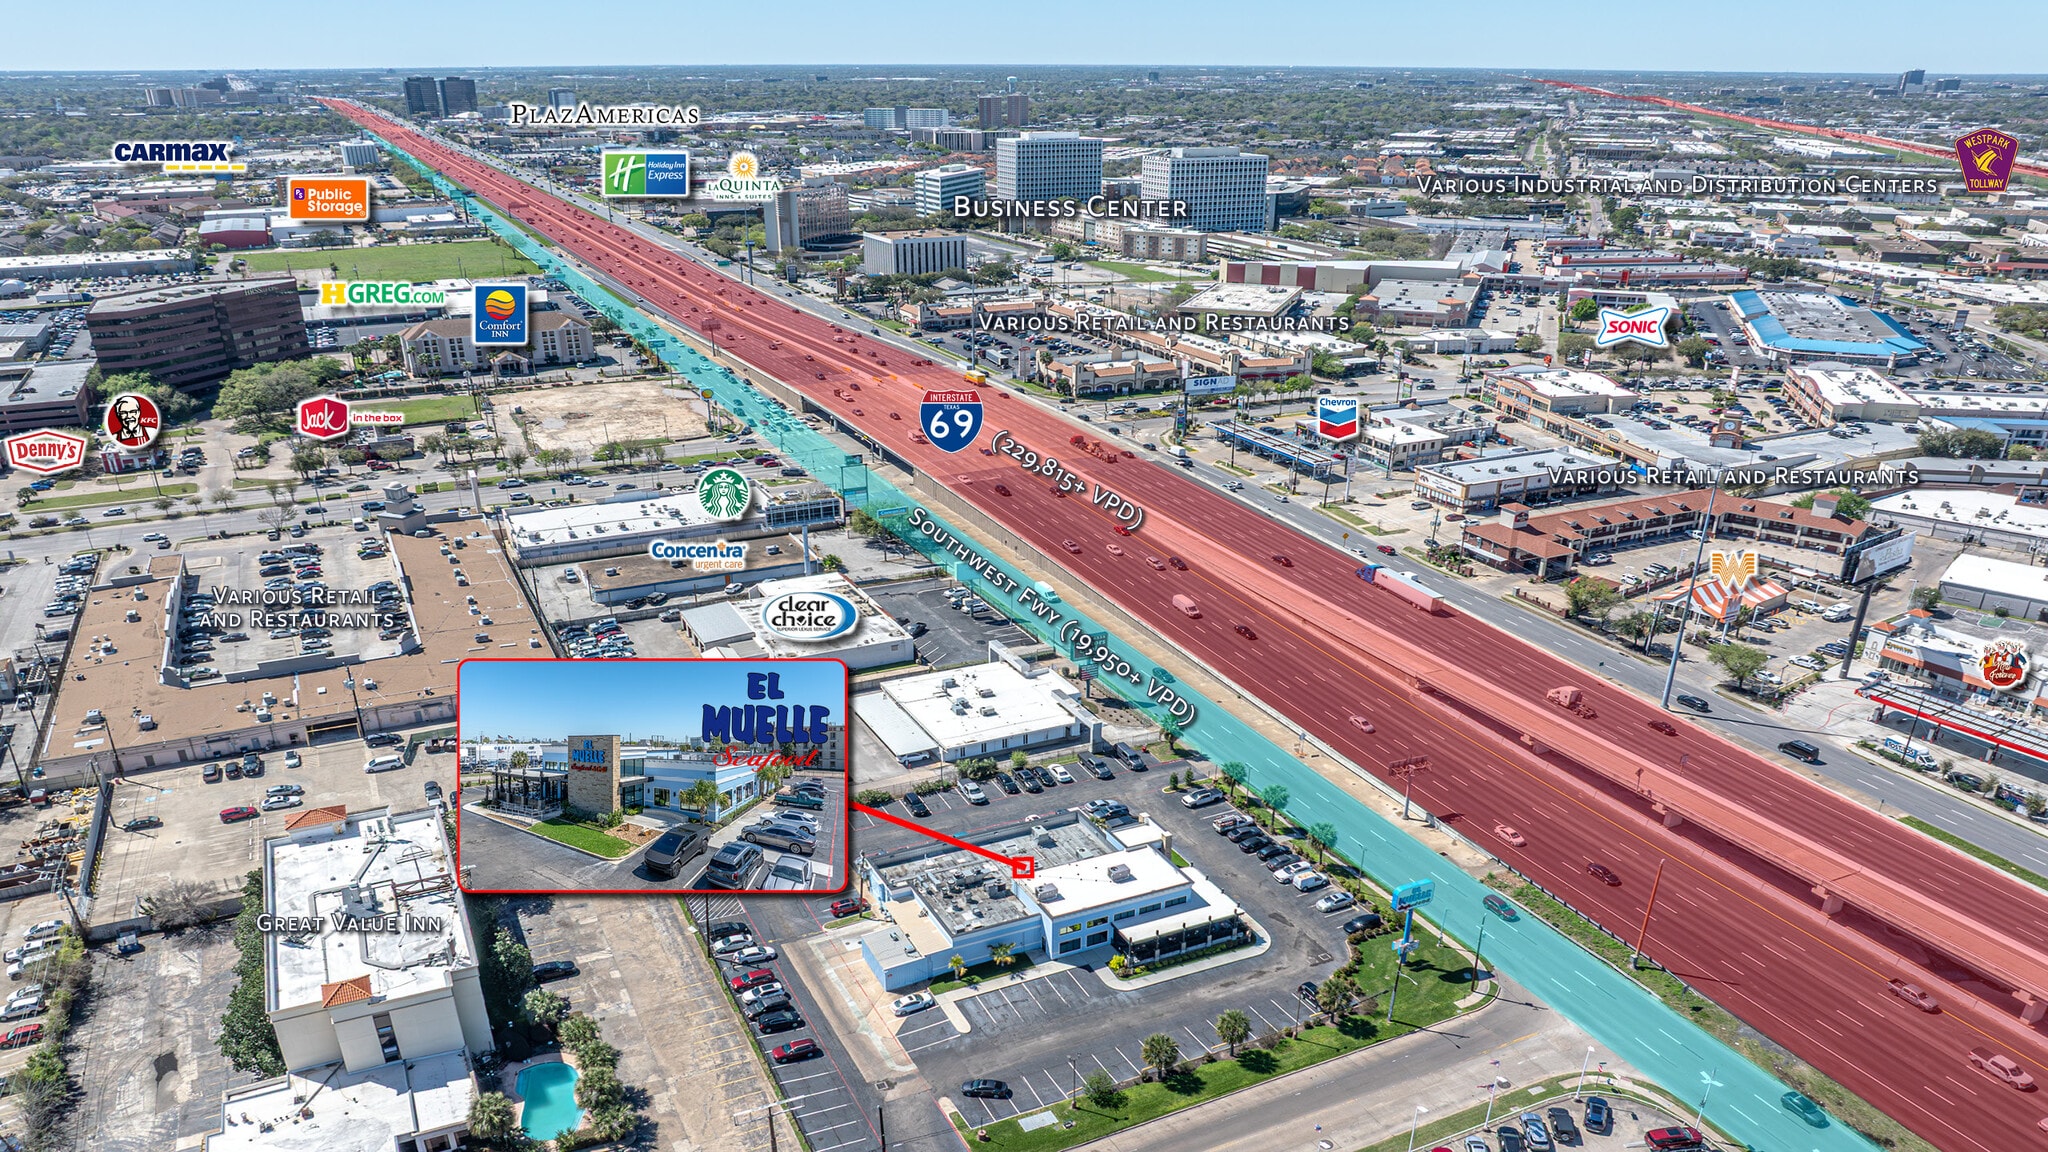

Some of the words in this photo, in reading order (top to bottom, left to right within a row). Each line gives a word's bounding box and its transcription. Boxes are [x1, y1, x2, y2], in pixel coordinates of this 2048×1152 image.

[1193, 379, 1217, 387] SIGN
[1888, 741, 1914, 755] TOSTOS
[572, 749, 605, 763] MUELLE
